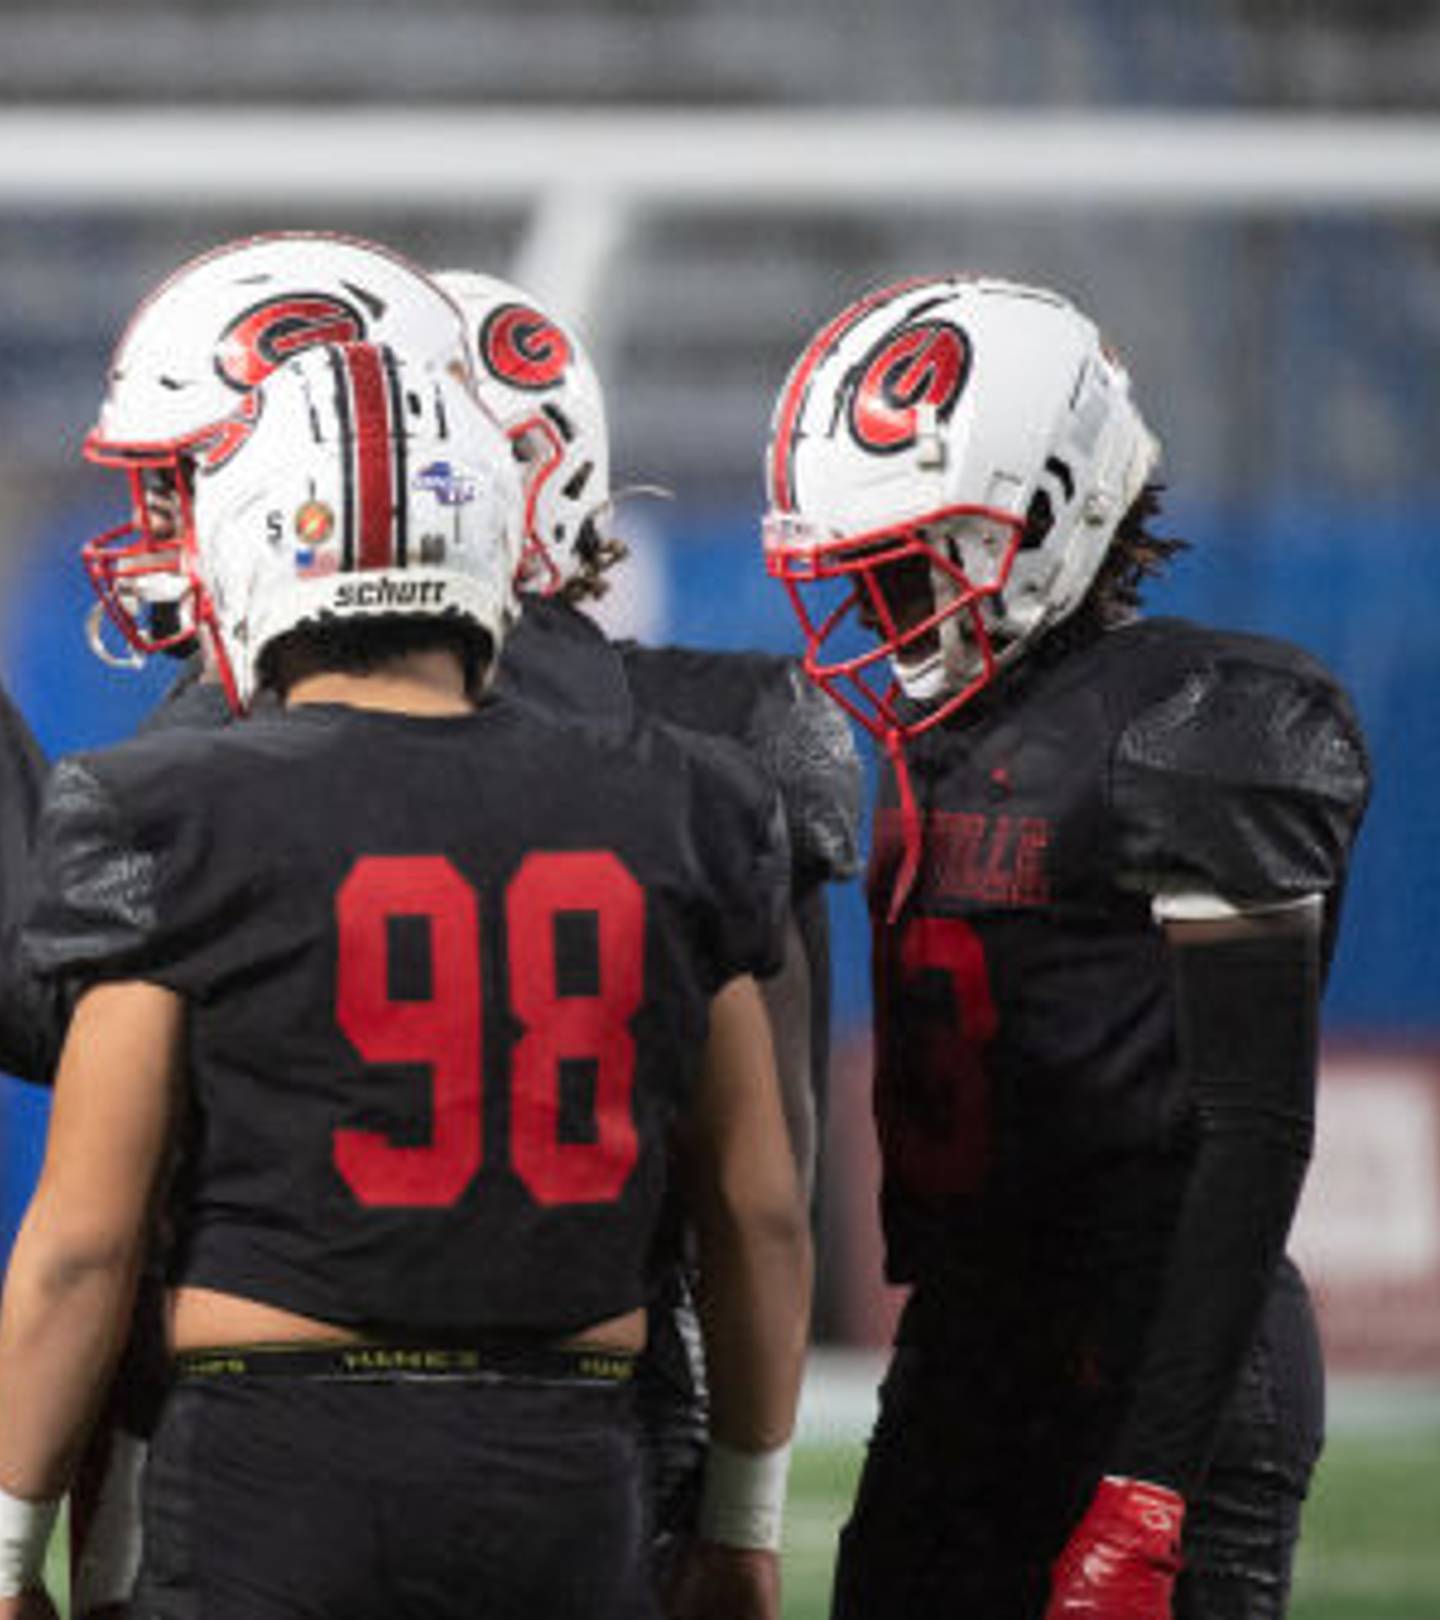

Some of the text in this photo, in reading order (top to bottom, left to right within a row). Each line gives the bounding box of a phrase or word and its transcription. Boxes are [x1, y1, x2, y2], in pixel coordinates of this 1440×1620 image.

[479, 303, 573, 391] G
[848, 319, 974, 455] G
[333, 850, 646, 1207] 98
